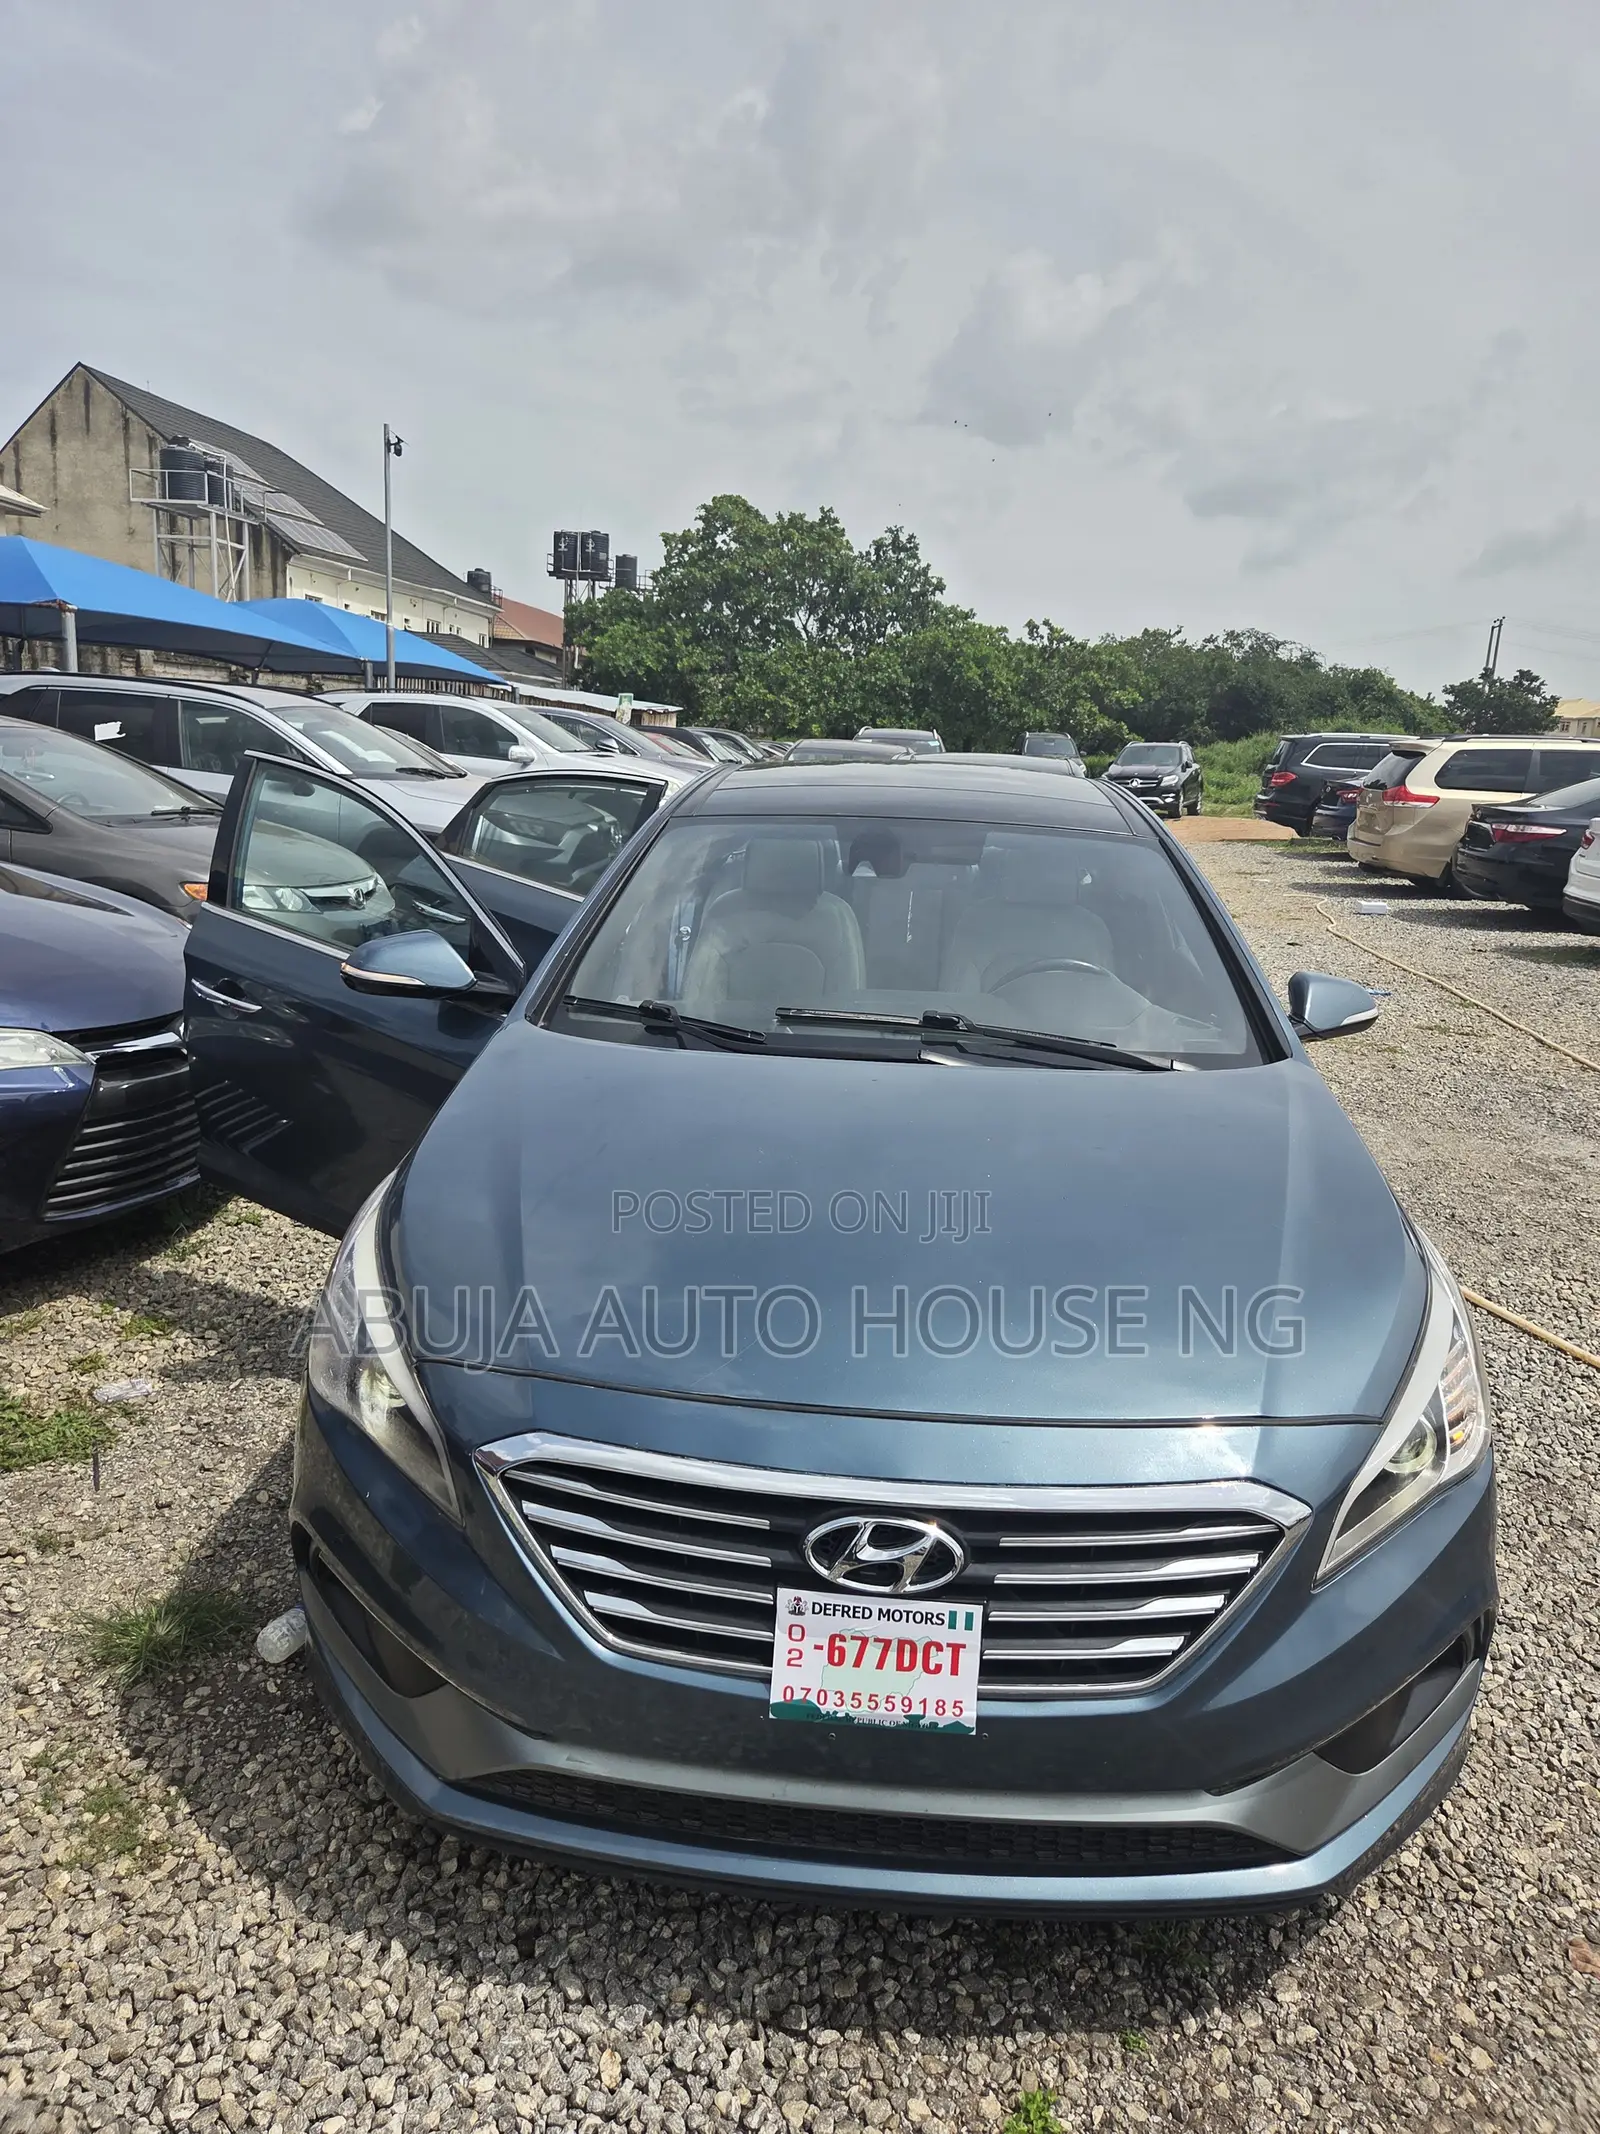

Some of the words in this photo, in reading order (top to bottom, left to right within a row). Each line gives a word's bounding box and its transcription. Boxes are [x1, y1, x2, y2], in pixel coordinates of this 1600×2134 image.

[811, 1601, 873, 1620] DEFRED
[877, 1607, 946, 1626] MOTORS
[783, 1685, 964, 1718] 07035559185
